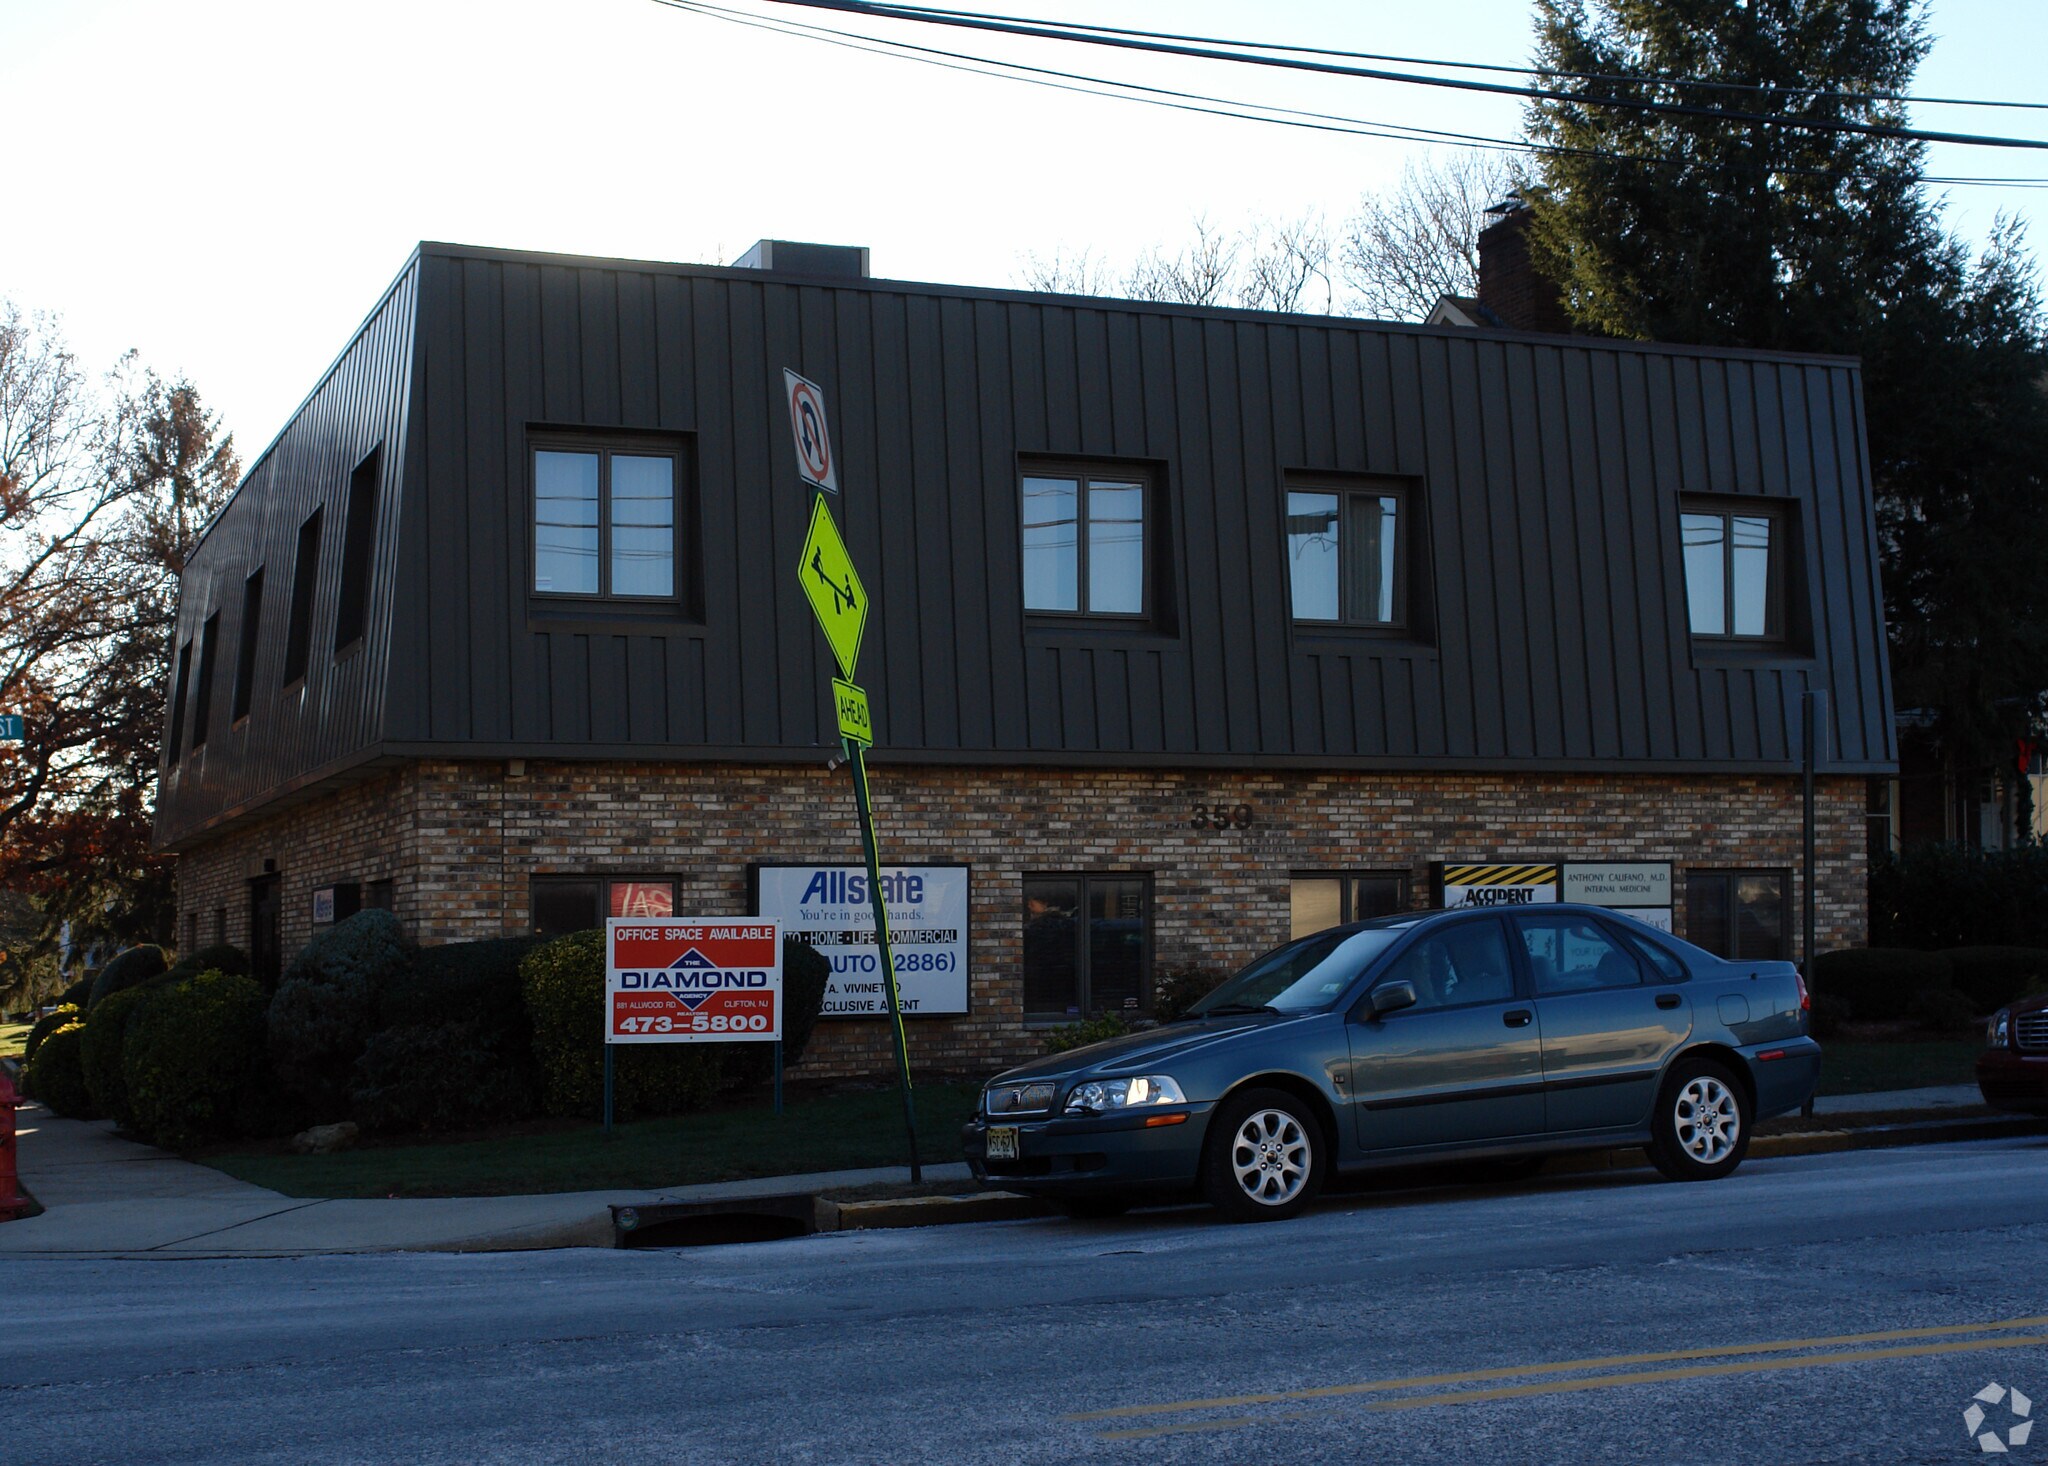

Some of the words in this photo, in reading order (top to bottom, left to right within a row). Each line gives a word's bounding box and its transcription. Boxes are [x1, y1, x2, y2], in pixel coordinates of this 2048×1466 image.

[840, 695, 868, 728] AHEAD
[1190, 803, 1253, 830] 359
[1567, 873, 1605, 882] ANTHONY
[1650, 873, 1668, 882] M.D.
[1465, 888, 1535, 903] ACCIDENT
[1584, 885, 1615, 893] INTERNAL
[1619, 885, 1651, 893] MEDICINE
[799, 909, 837, 921] You're
[840, 909, 850, 920] in
[854, 911, 876, 924] goo
[888, 909, 925, 921] hands.
[616, 928, 659, 941] OFFICE
[664, 928, 703, 940] SPACE
[709, 927, 773, 940] AVAILABLE
[810, 931, 844, 945] HOME
[852, 931, 875, 944] LIFE
[621, 971, 767, 989] DIAMOND
[828, 983, 839, 994] A.
[844, 982, 902, 994] VIVINETO
[616, 1001, 628, 1009] 881
[630, 1001, 664, 1009] ALLWOOD
[665, 1001, 677, 1009] RD.
[724, 1000, 757, 1009] CLIFTON,
[758, 1000, 769, 1008] NJ
[879, 999, 920, 1011] AENT
[619, 1015, 768, 1033] 473-5800
